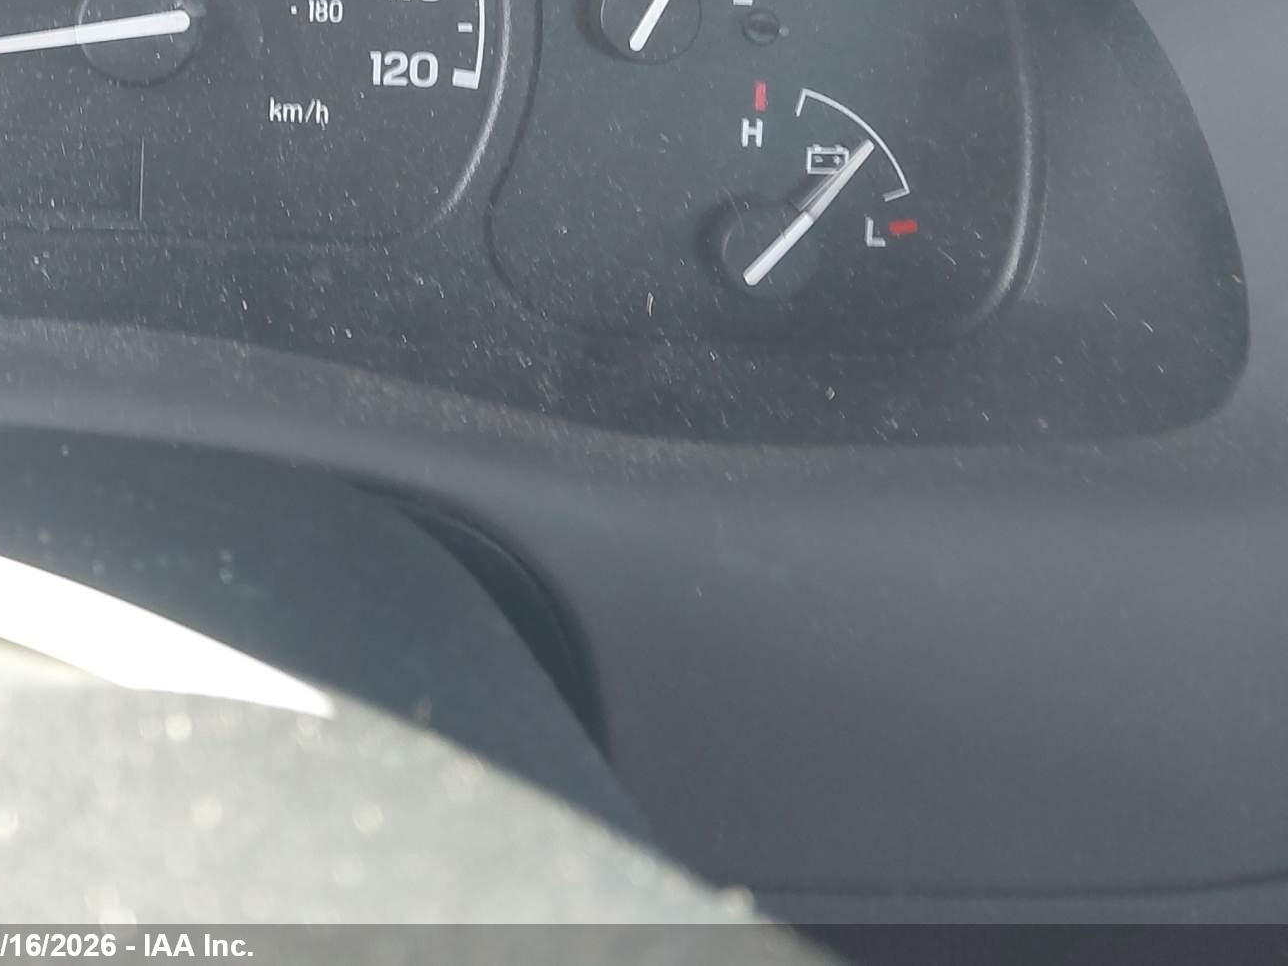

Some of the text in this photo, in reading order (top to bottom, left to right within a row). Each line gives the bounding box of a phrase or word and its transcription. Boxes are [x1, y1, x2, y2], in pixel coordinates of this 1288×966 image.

[308, 0, 343, 23] 180
[370, 51, 438, 87] 120
[269, 99, 329, 125] km/h
[742, 118, 763, 146] H
[865, 216, 886, 247] L
